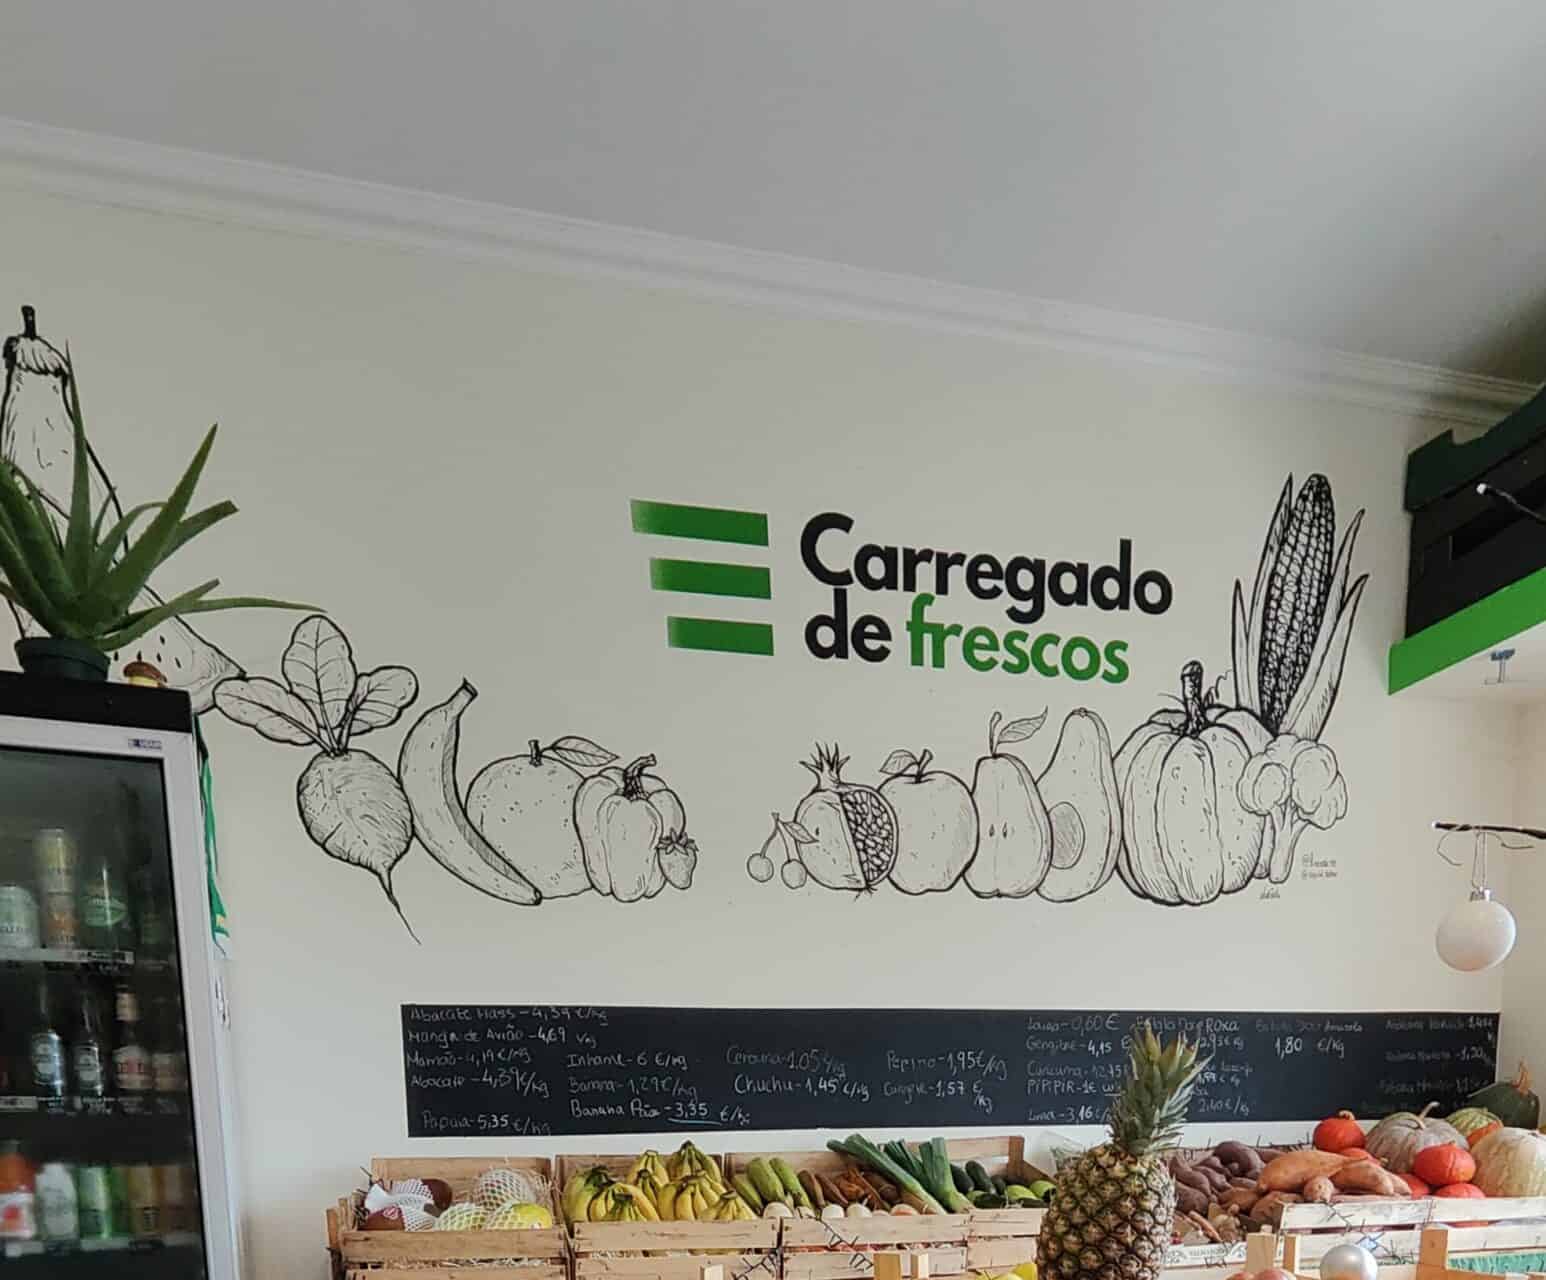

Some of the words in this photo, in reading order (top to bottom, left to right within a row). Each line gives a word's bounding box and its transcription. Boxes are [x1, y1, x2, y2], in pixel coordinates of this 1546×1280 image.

[800, 512, 1172, 624] Carregado
[804, 587, 891, 663] de
[906, 593, 1129, 684] frescos
[1274, 1036, 1302, 1060] 1,80
